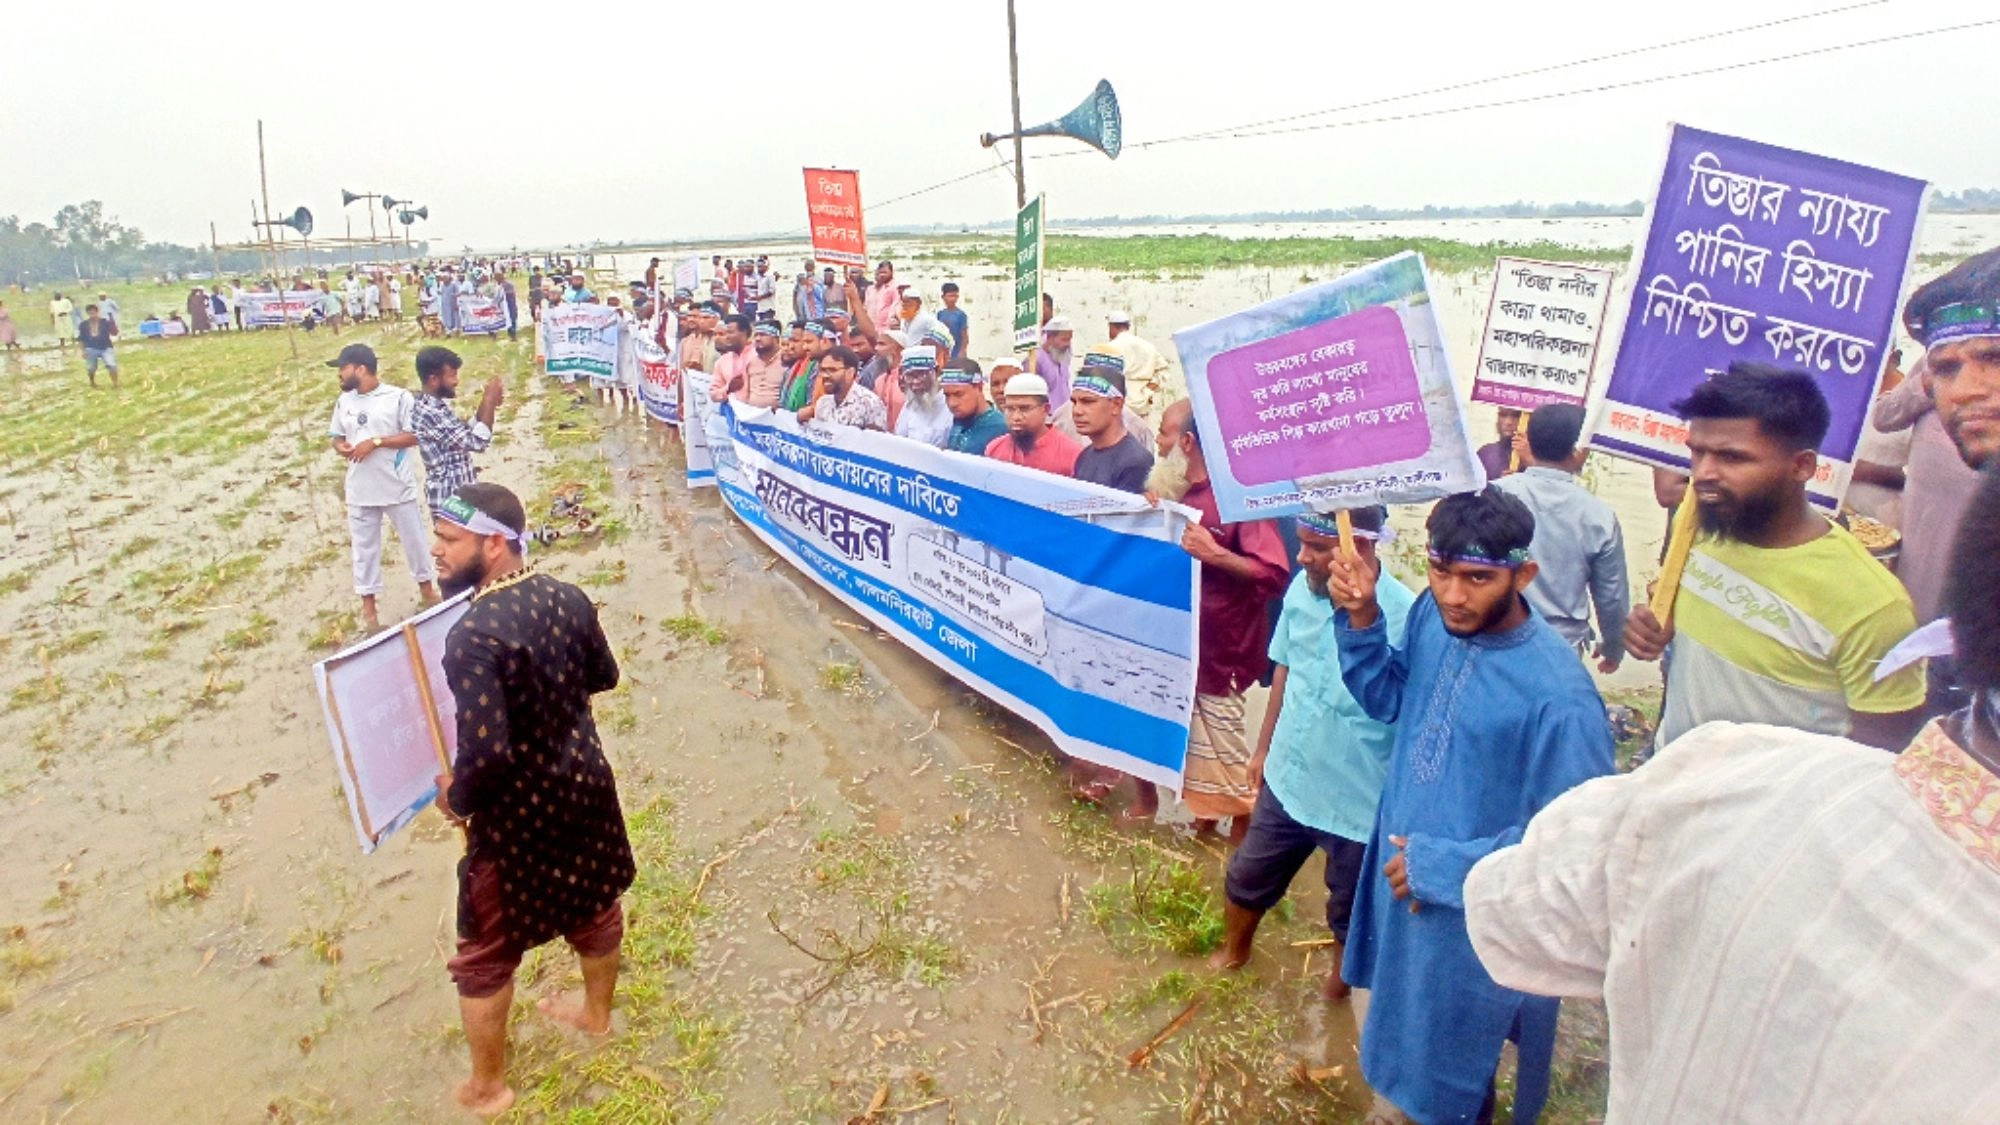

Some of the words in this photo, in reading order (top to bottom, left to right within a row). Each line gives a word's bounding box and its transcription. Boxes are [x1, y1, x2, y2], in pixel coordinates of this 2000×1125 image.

[1686, 151, 1791, 225] তিস্তার
[1558, 274, 1598, 297] নদীর
[1675, 222, 1772, 288] পানির
[1778, 239, 1874, 314] হিস্যা
[1493, 329, 1593, 358] মহাপরিকল্পনা
[1500, 300, 1536, 321] কান্না
[1642, 274, 1757, 346] নিশ্চিত
[1765, 313, 1876, 375] করতে
[1485, 357, 1538, 378] বাস্তবায়ন
[755, 469, 895, 568] মানববন্ধন
[809, 449, 892, 497] বাস্তবায়নের
[896, 472, 962, 519] দাবিতে
[855, 576, 935, 631] লালমনিরহাট
[938, 626, 979, 663] জেলা
